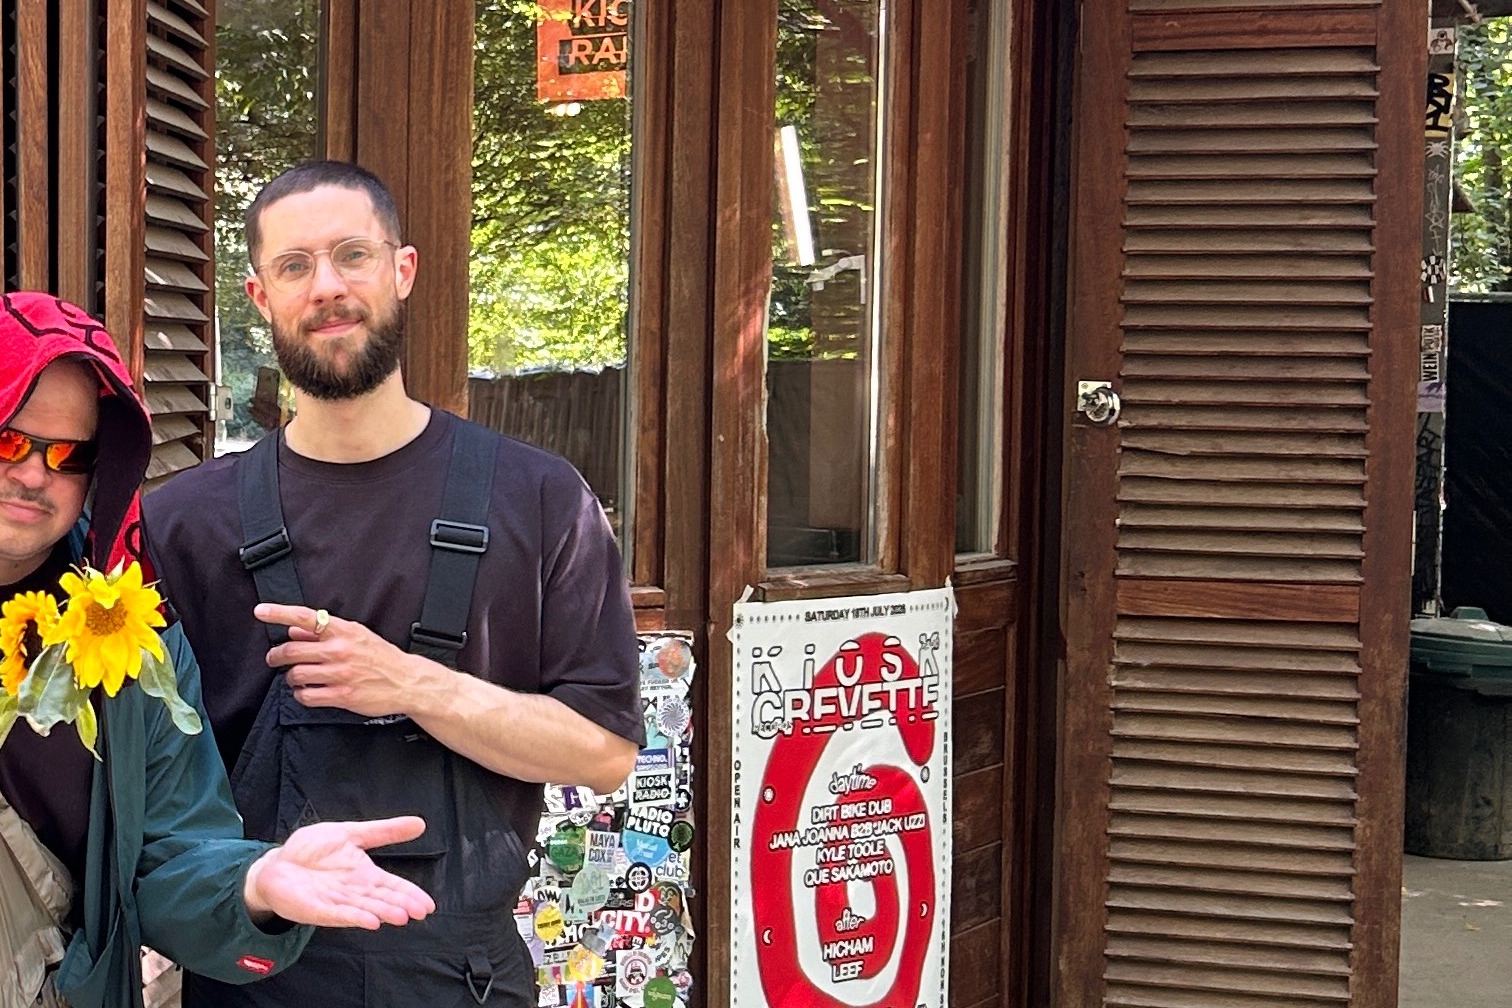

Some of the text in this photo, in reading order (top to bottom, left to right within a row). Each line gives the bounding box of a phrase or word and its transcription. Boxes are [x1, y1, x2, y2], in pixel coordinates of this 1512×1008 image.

[805, 608, 850, 622] SATURDAY
[871, 605, 890, 617] JULY
[752, 676, 939, 739] CREVETTE
[636, 775, 668, 788] KIOSK
[829, 764, 877, 794] daytime
[635, 787, 671, 801] RADIO
[631, 806, 673, 824] RADIO
[811, 798, 893, 825] DIRT BIKE DUB
[627, 816, 670, 838] PLUTO
[733, 813, 741, 849] AIR
[769, 831, 803, 851] JANA
[802, 823, 850, 847] JOANNA
[851, 821, 873, 839] B2B
[590, 832, 615, 848] MAYA
[816, 838, 885, 864] KYLE TOOLE
[588, 848, 606, 862] COX
[666, 852, 682, 863] et
[655, 865, 684, 878] club
[804, 858, 894, 888] QUE SAKAMOTO
[834, 907, 866, 933] after
[823, 934, 874, 962] HICHAM
[832, 960, 865, 983] LEEF
